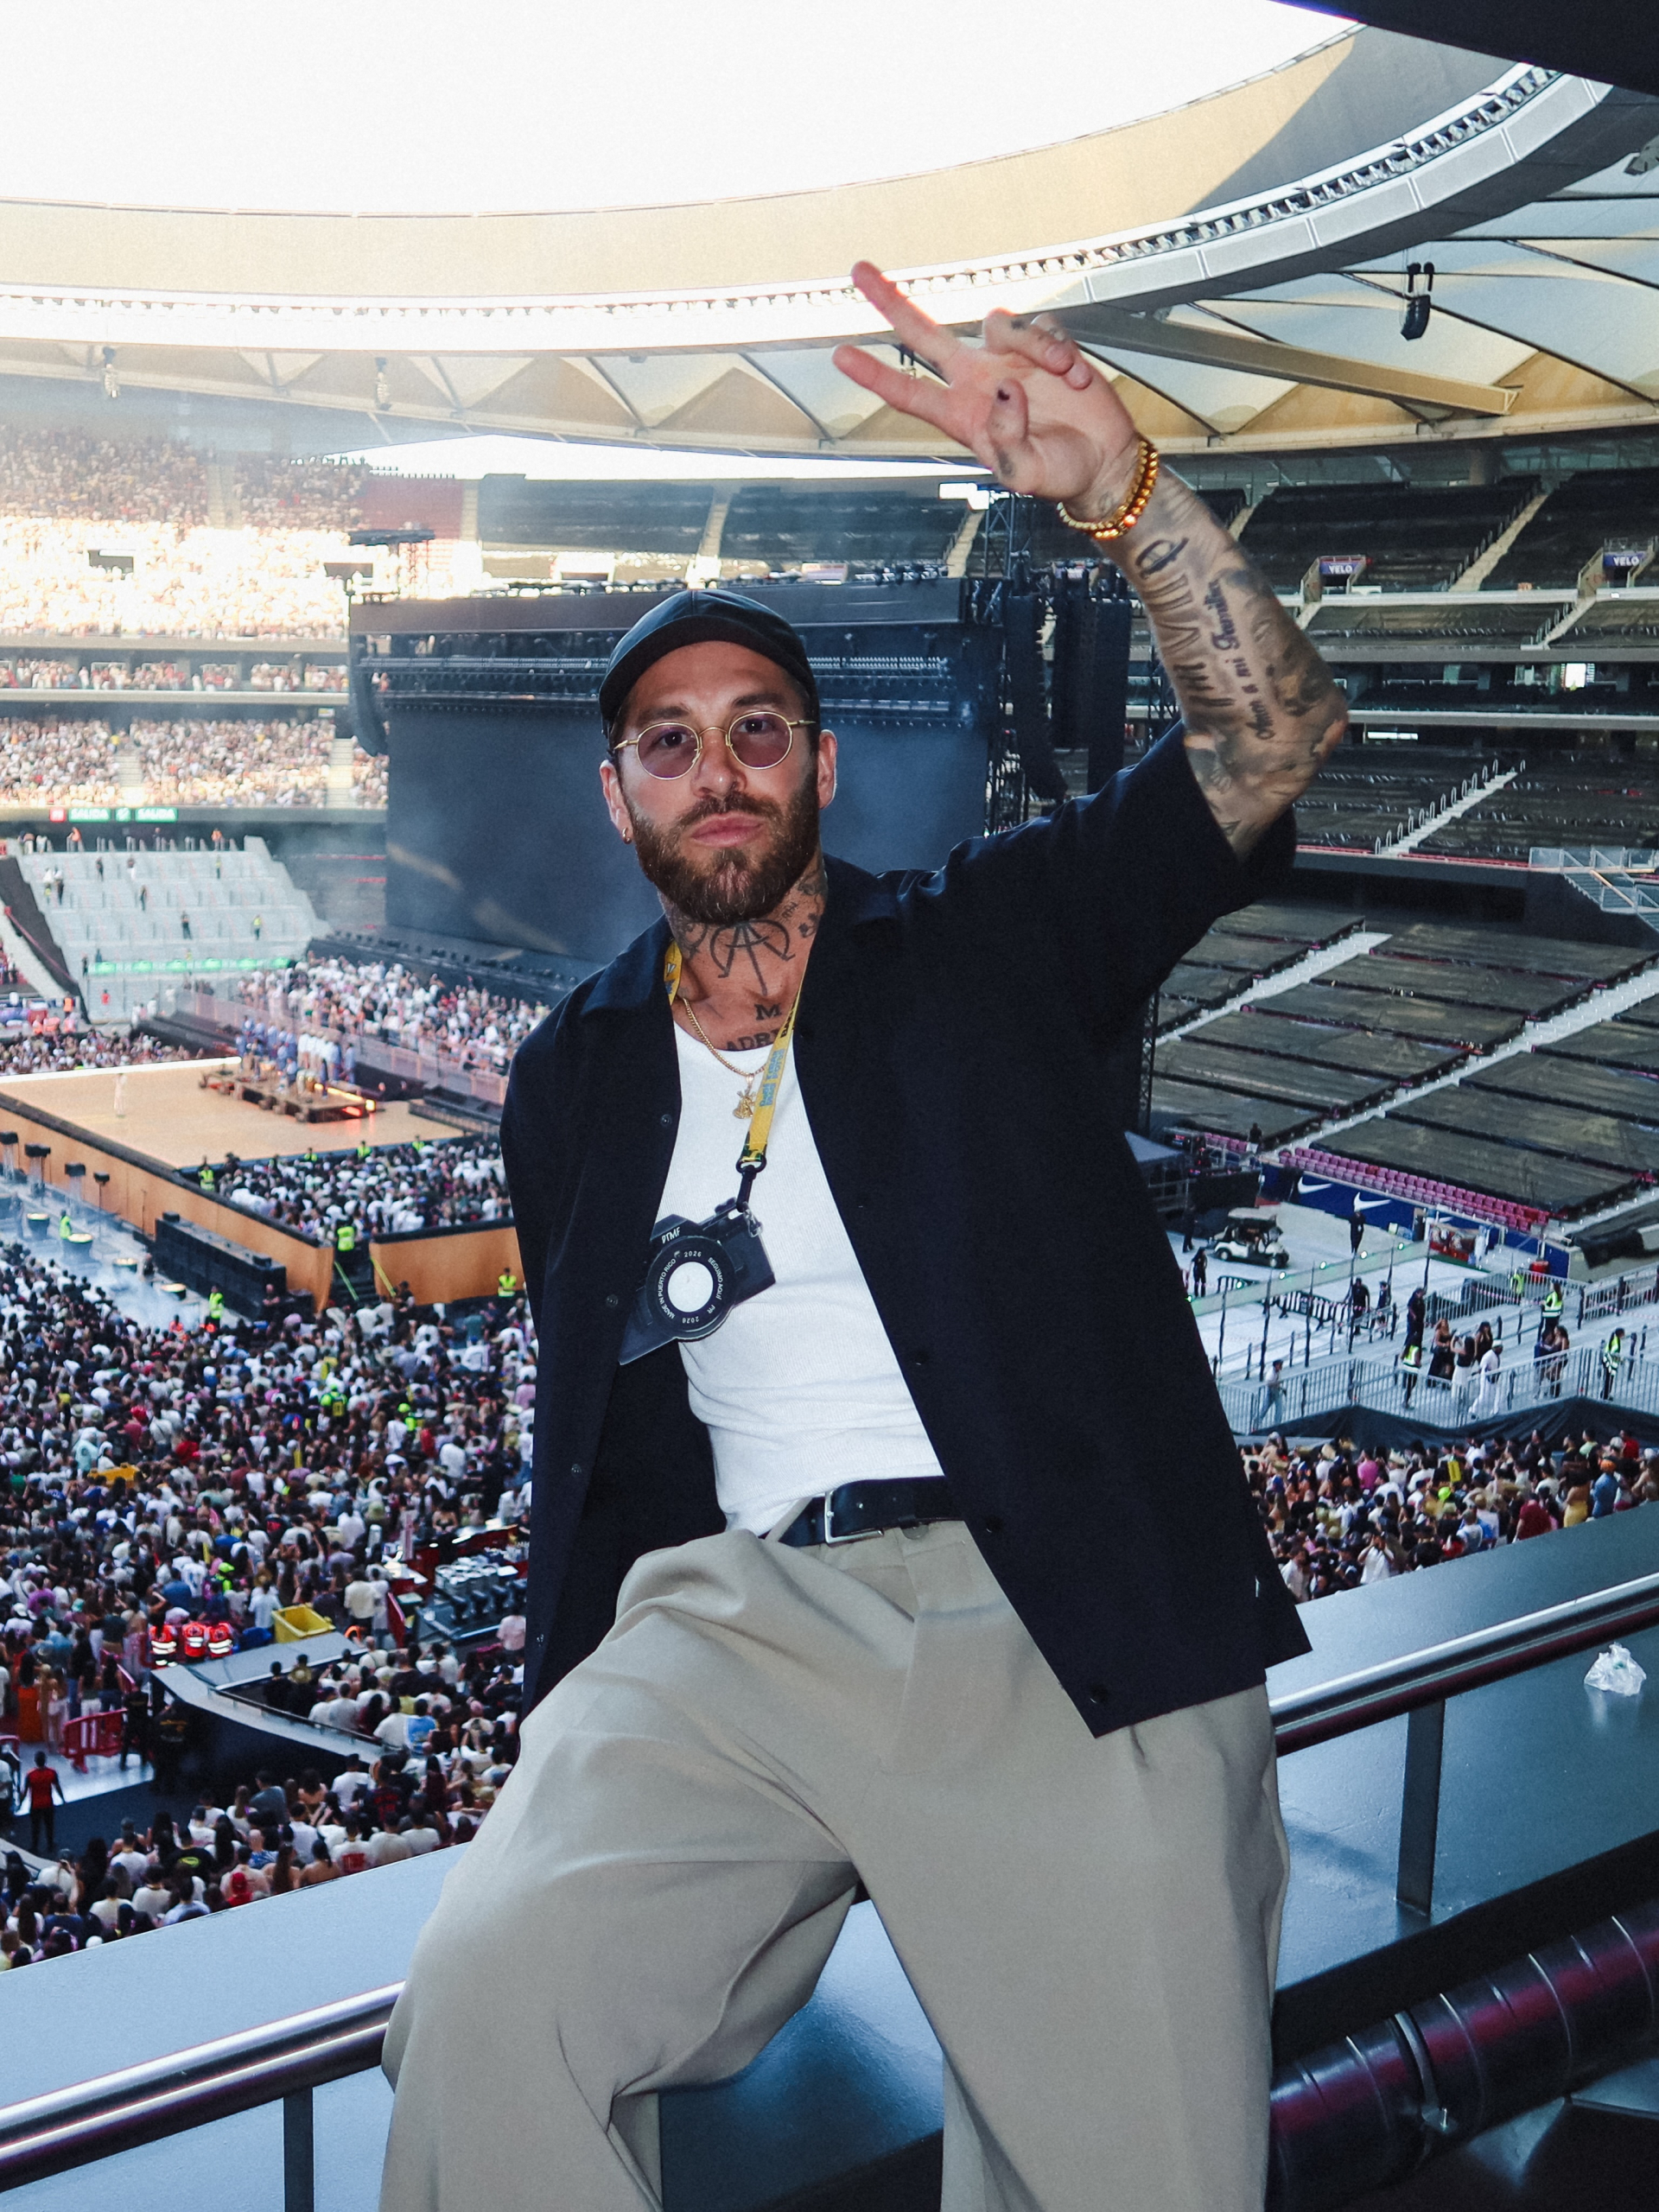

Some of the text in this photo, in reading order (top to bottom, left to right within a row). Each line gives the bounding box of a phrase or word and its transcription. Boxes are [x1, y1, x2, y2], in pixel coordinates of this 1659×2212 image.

[1612, 556, 1640, 567] VELO
[1329, 565, 1353, 574] VELO
[71, 808, 175, 820] SALIDA SALIDA
[753, 1003, 782, 1020] M
[661, 1226, 681, 1244] DTMF
[664, 1258, 676, 1273] RICO
[658, 1272, 667, 1297] PUERTO
[661, 1305, 676, 1319] MADE
